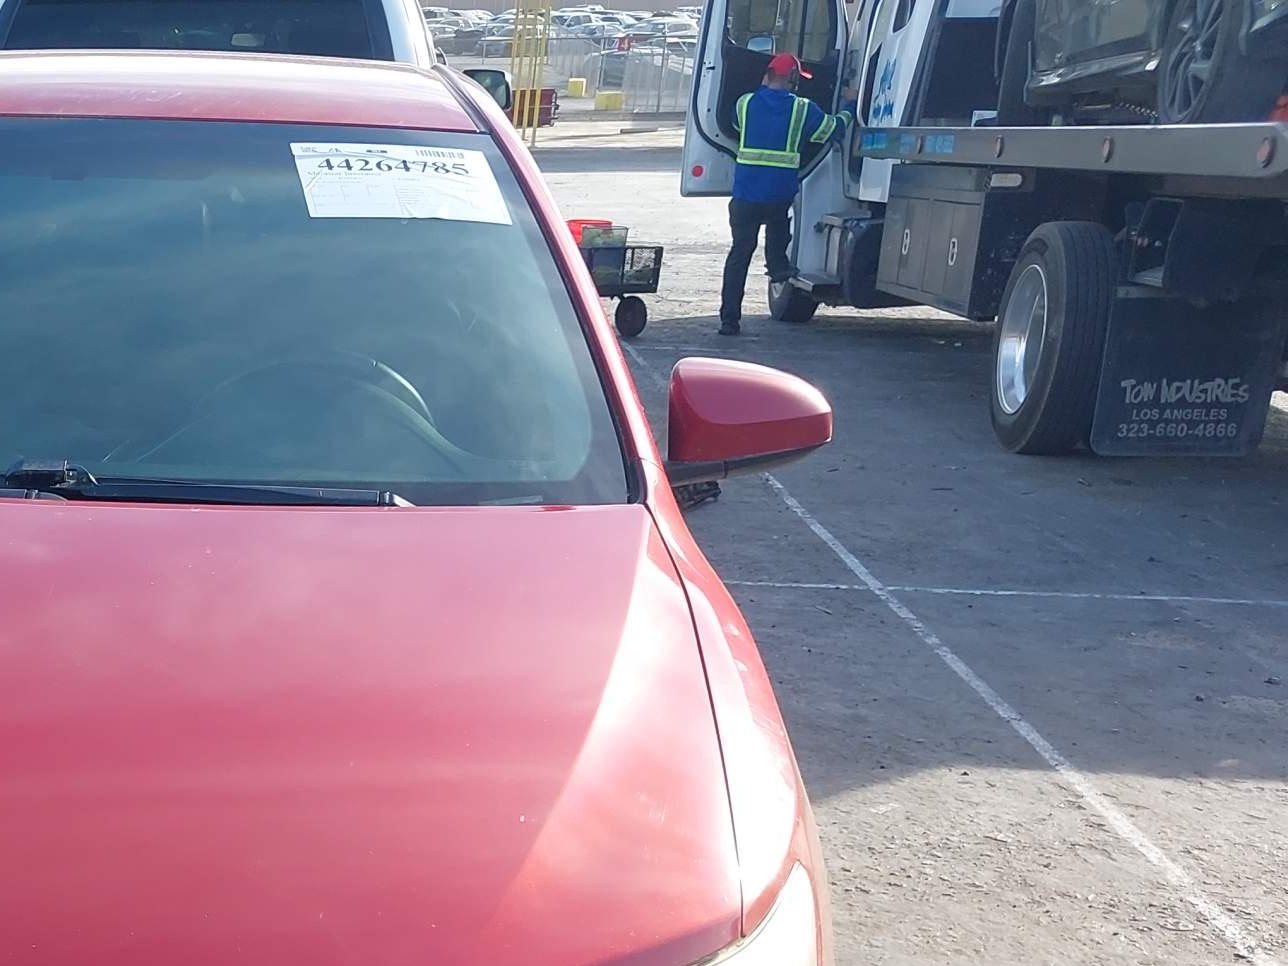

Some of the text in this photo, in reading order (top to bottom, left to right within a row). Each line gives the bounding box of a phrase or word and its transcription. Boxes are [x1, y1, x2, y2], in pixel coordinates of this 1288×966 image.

[317, 157, 470, 176] 44264785
[1131, 408, 1227, 421] LOS ANGELES
[1116, 423, 1237, 438] 323-660-4866
